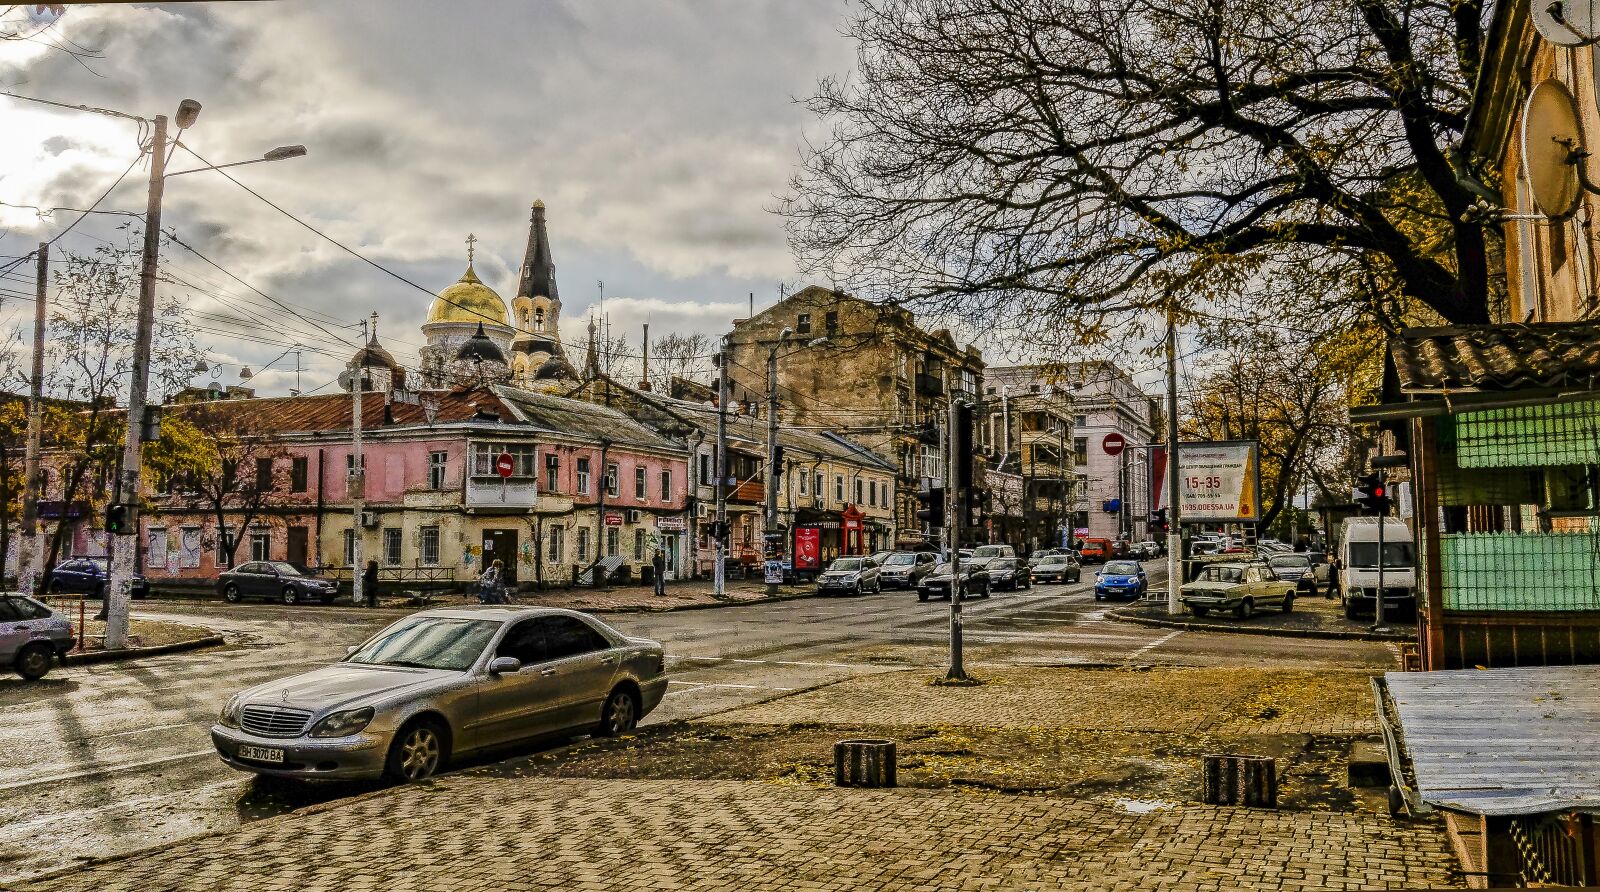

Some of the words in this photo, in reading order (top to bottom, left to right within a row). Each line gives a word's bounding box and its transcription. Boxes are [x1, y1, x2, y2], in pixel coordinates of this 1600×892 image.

[1185, 477, 1220, 488] 15-35
[241, 745, 251, 757] BH
[252, 748, 269, 760] 3070
[270, 750, 281, 761] BA
